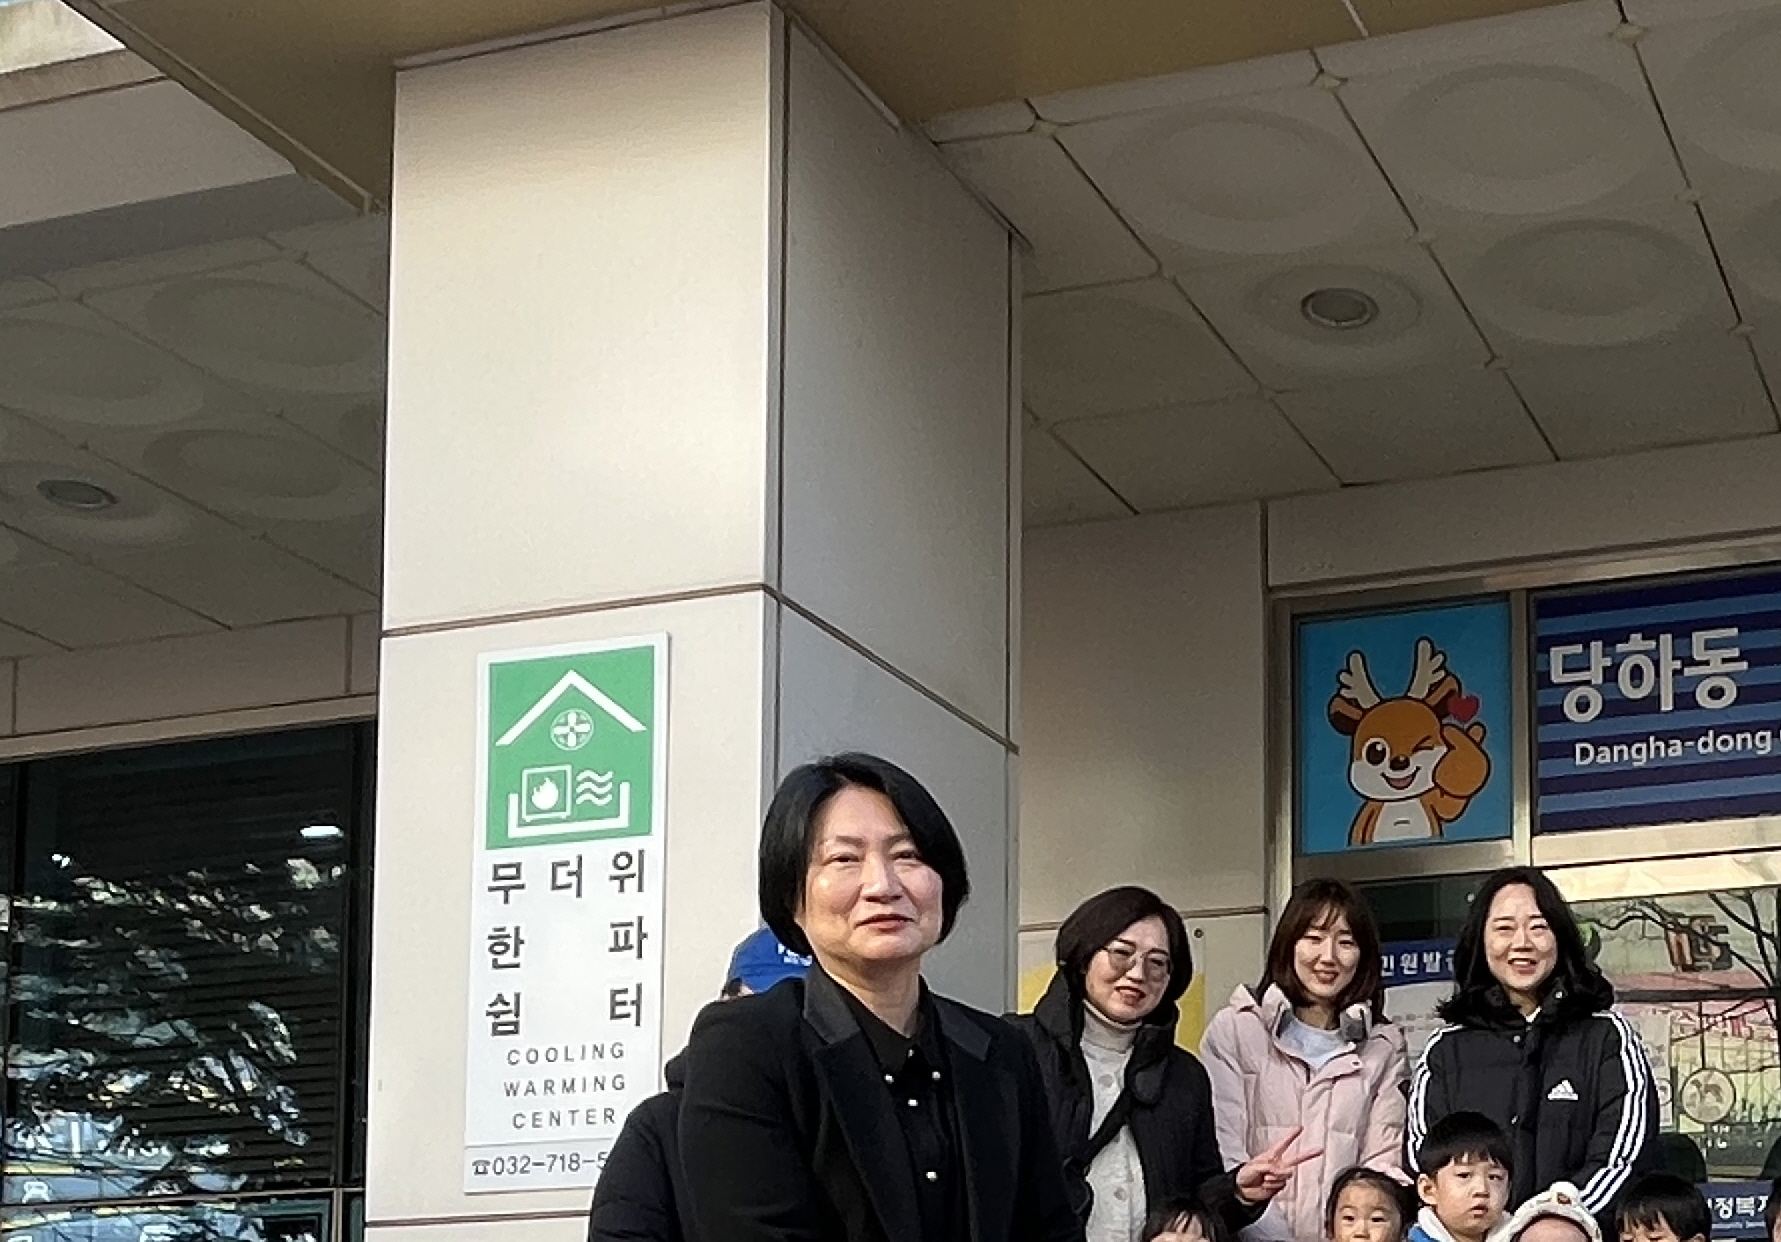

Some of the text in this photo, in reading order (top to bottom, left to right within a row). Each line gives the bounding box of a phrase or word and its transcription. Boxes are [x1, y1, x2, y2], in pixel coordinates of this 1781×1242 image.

[1549, 627, 1749, 723] 당하동
[1574, 727, 1772, 768] Dangha-dong
[487, 848, 646, 905] 무더위
[507, 1042, 626, 1066] COOLING
[503, 1074, 627, 1099] WARMING
[512, 1107, 617, 1130] CENTER
